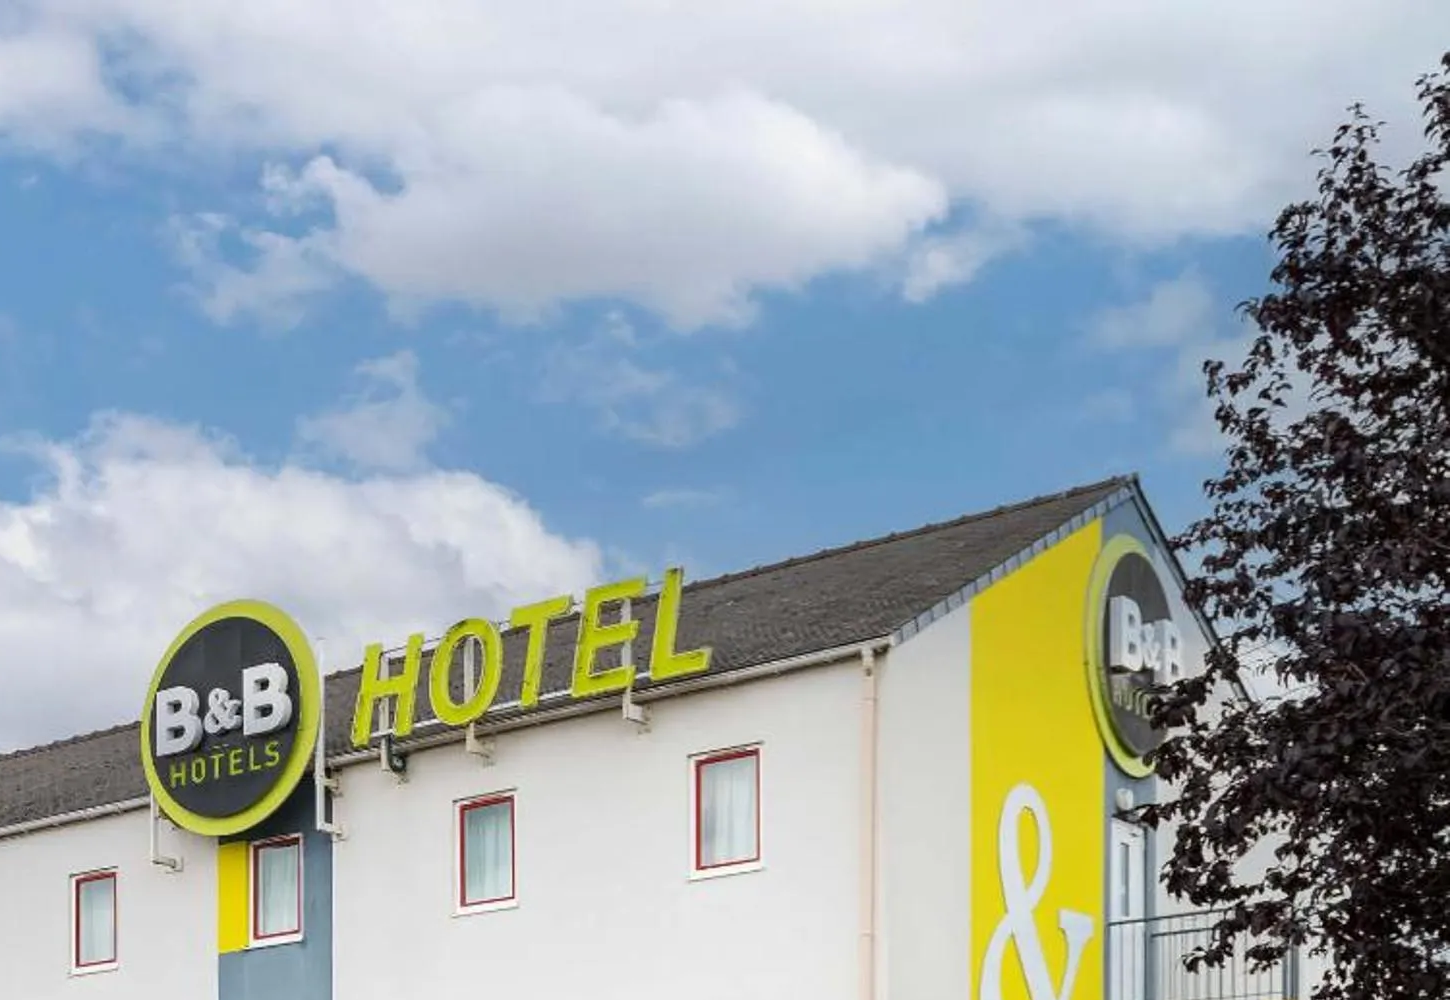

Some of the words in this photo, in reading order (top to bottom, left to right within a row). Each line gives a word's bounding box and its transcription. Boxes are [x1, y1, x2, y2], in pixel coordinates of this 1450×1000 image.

[349, 565, 713, 748] HOTEL
[156, 661, 293, 758] B&B
[169, 740, 281, 789] HOTELS
